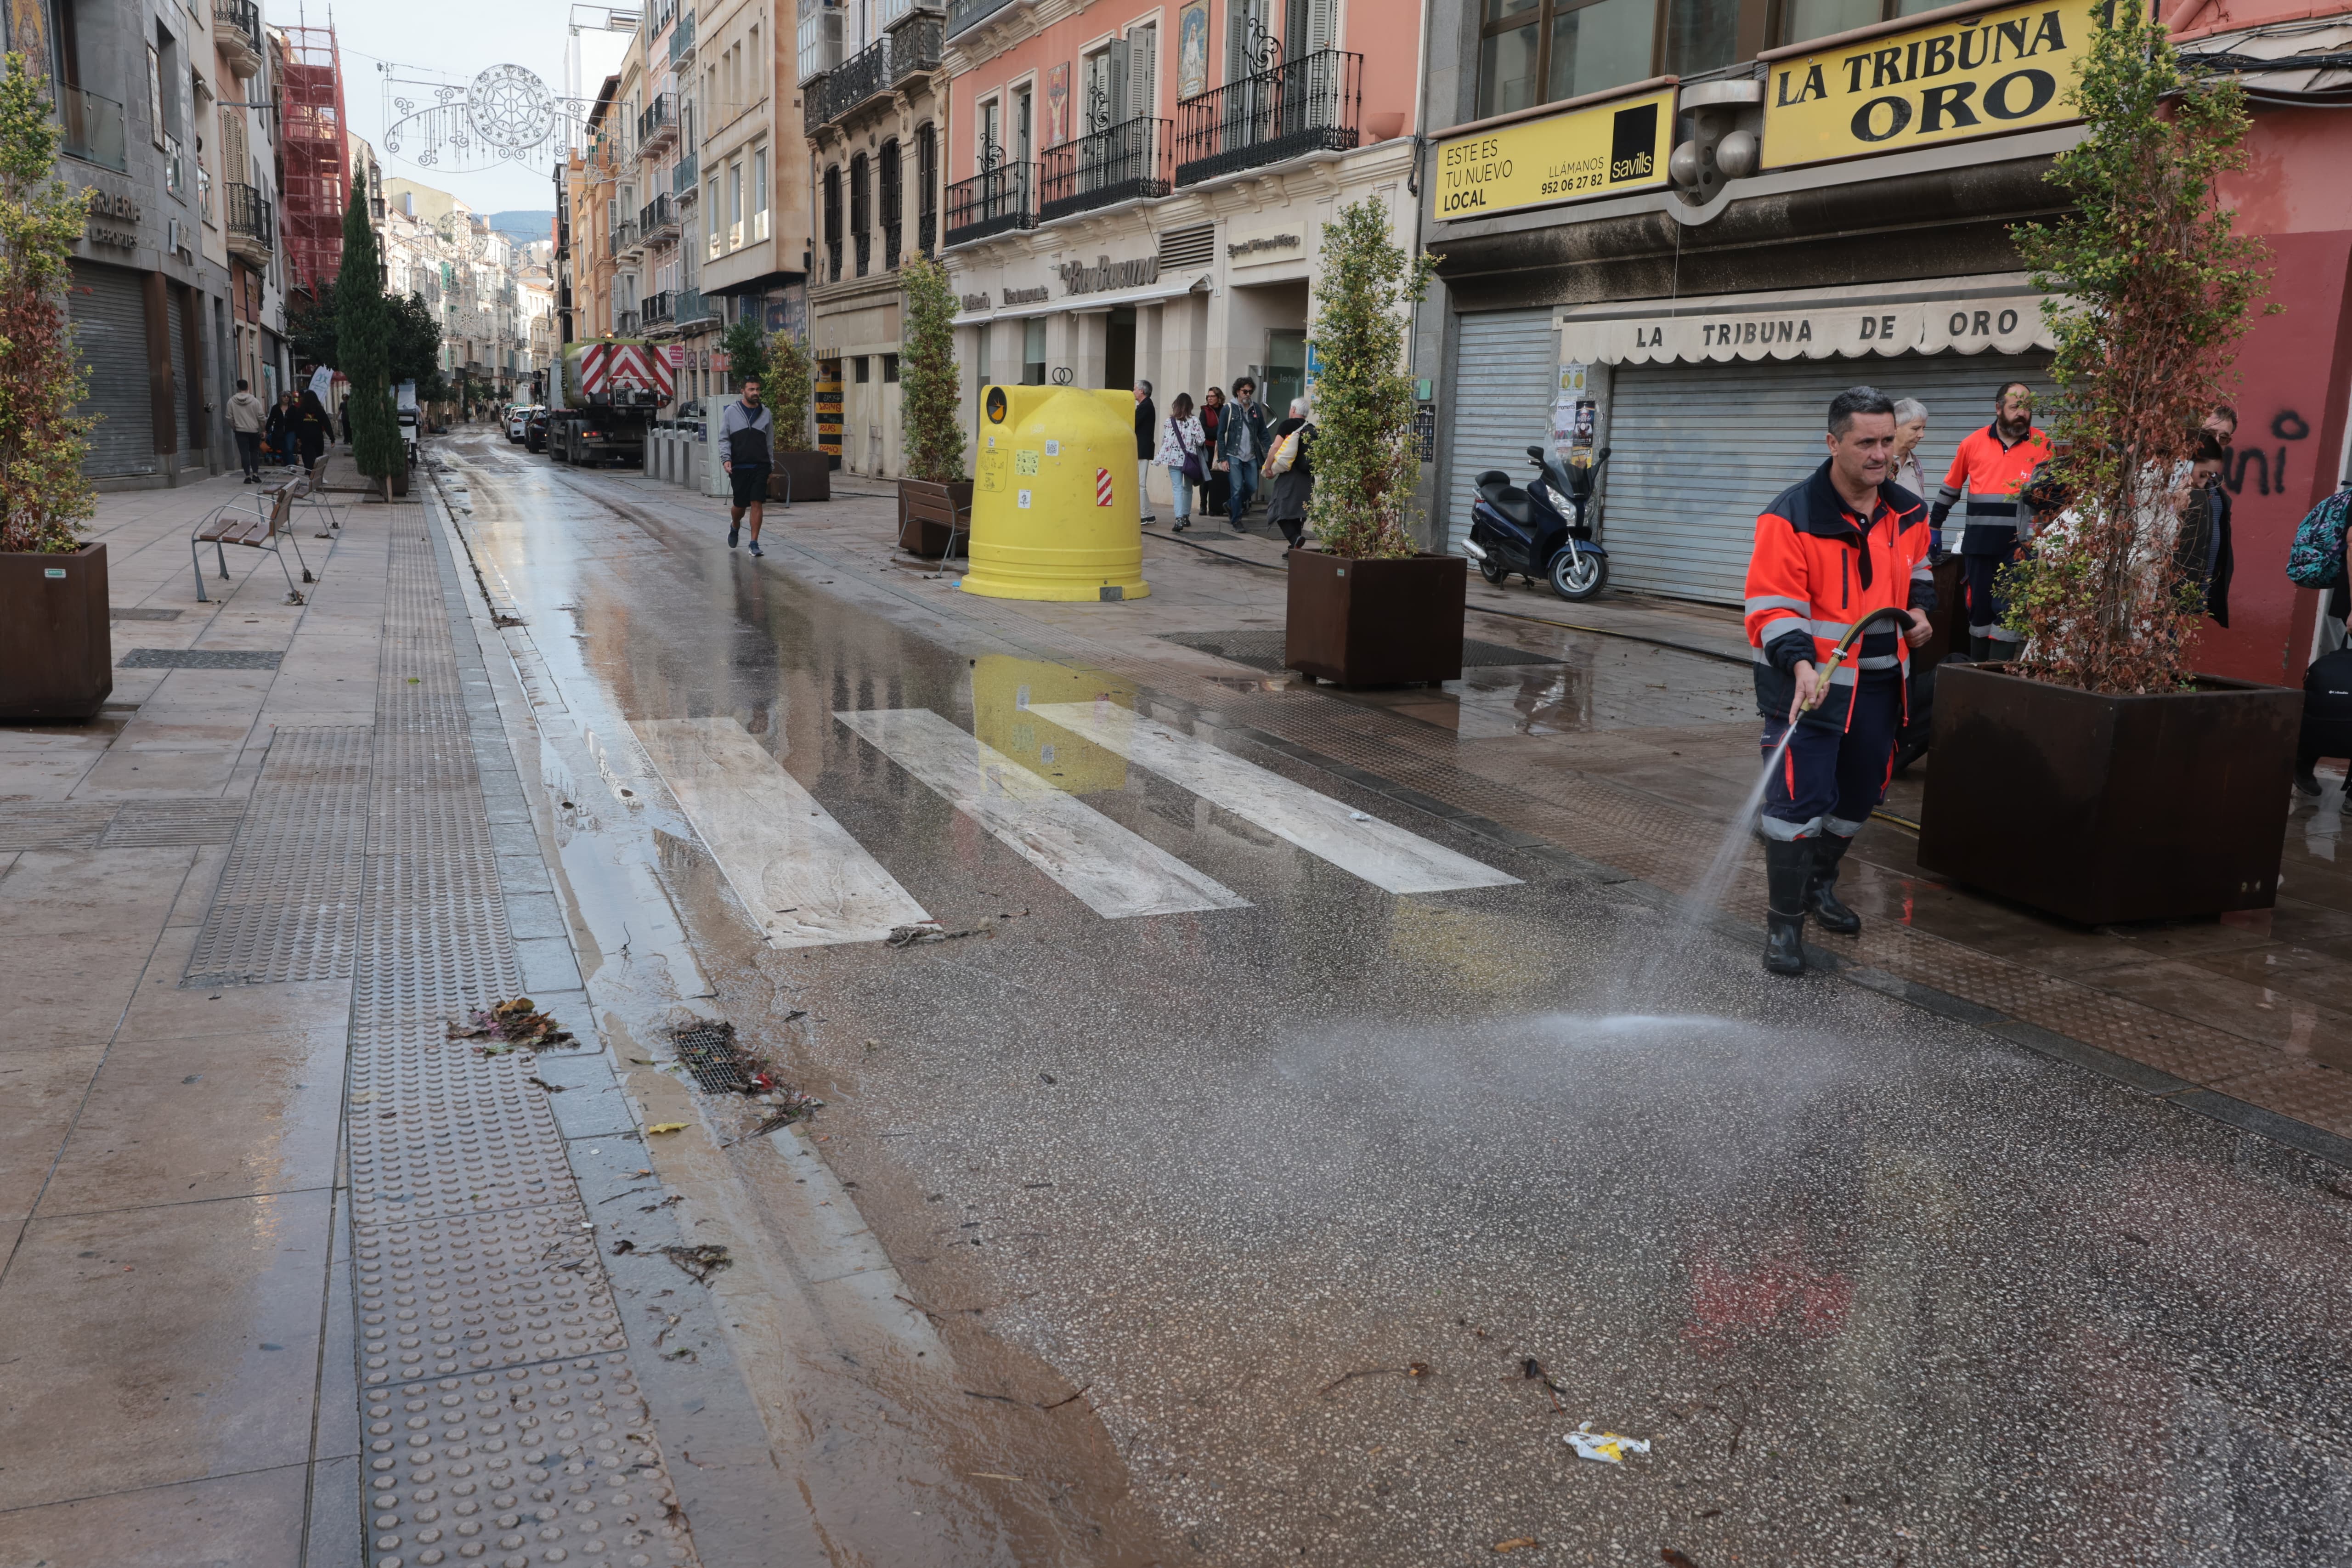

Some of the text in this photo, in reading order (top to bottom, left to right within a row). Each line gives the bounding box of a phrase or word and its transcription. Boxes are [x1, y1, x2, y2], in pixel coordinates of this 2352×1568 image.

[1775, 63, 1828, 108] LA
[1842, 10, 2067, 93] TRIBUNA
[1850, 69, 2056, 142] ORO
[1447, 139, 1498, 166] ESTE ES
[1612, 151, 1651, 178] savills
[1446, 159, 1513, 189] TU NUEVO
[1549, 157, 1604, 178] LLÁMANOS
[1541, 173, 1602, 194] 952 06 27 82
[1444, 189, 1486, 211] LOCAL
[1636, 309, 2018, 348] LA TRIBUNA DE ORO
